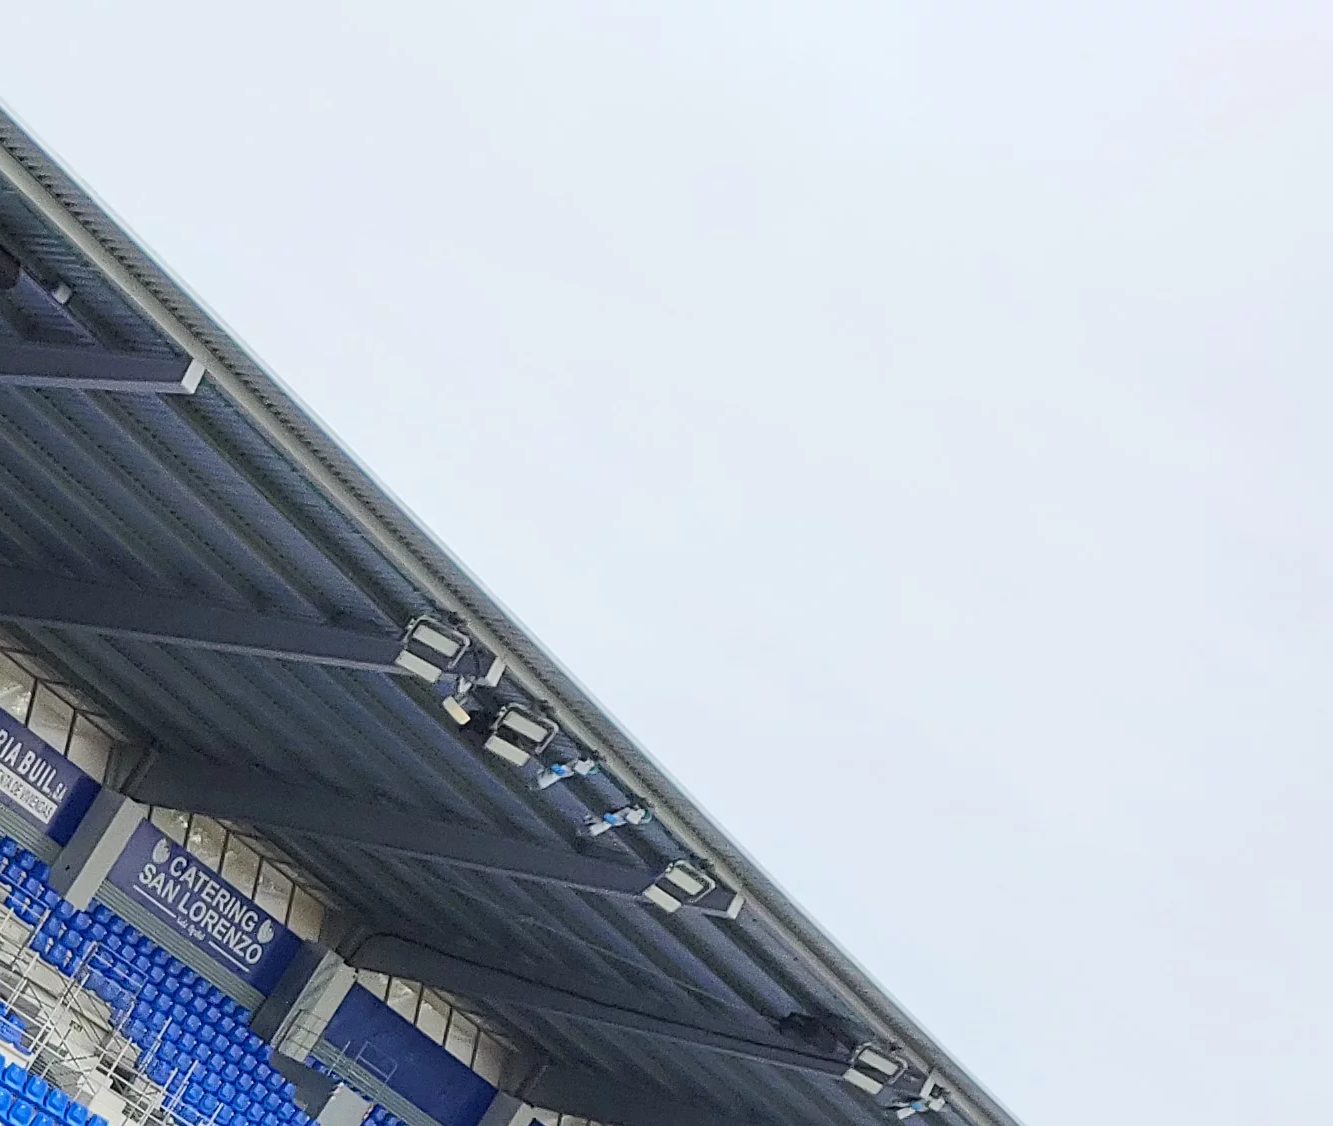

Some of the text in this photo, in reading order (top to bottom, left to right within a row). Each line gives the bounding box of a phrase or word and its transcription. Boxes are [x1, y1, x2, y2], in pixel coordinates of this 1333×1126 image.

[139, 864, 179, 903] SAN
[178, 892, 262, 964] LORENZO
[171, 857, 259, 932] CATERING
